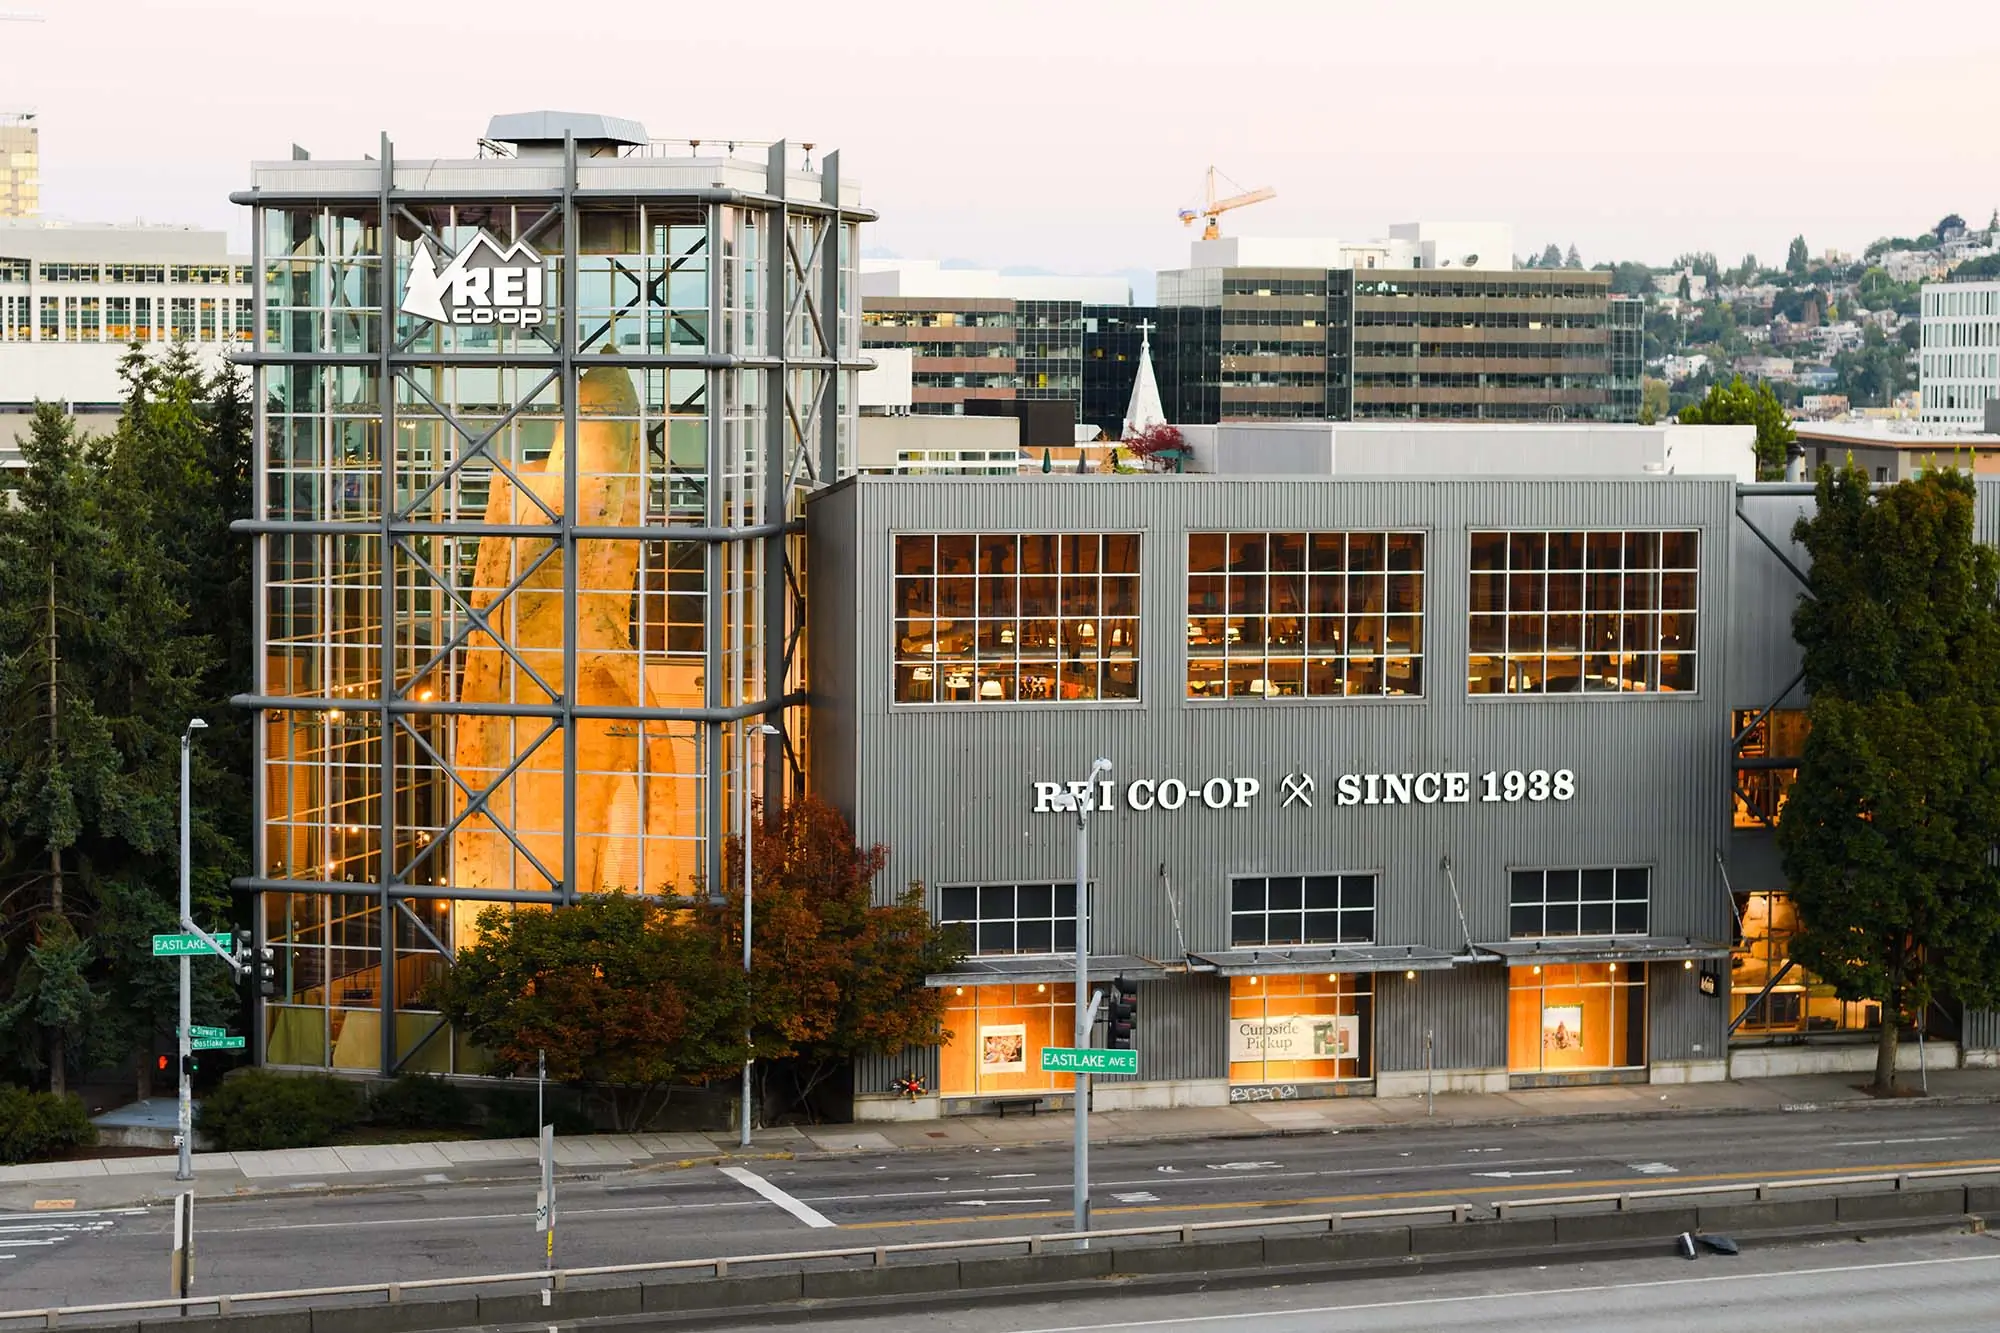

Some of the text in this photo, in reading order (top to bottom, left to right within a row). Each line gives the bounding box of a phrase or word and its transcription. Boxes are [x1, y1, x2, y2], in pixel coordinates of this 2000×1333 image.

[452, 267, 542, 306] REI
[1033, 768, 1576, 812] REI CO-OP SINCE 1938
[155, 939, 207, 951] EASTLAKE
[1240, 1022, 1299, 1035] Curbside
[1247, 1036, 1293, 1050] Pickup
[1043, 1053, 1135, 1068] EASTLAKE AVE E
